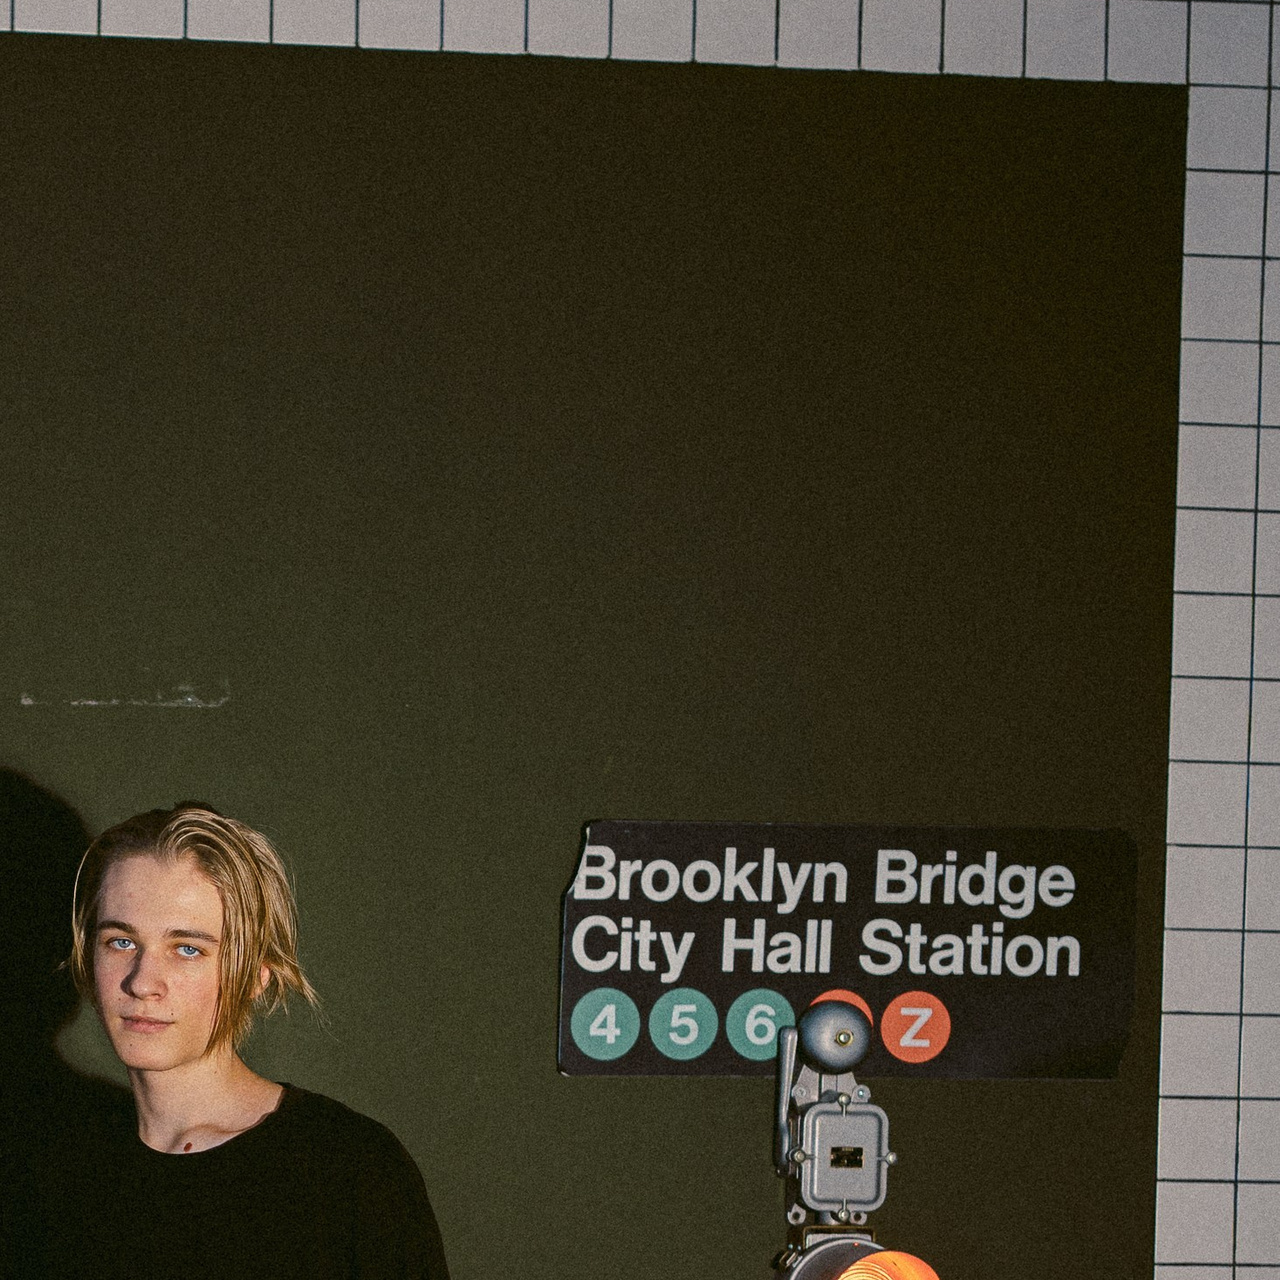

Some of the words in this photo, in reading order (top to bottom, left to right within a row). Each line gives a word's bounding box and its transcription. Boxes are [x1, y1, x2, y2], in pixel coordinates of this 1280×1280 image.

[573, 845, 848, 914] Brooklyn
[875, 849, 1076, 918] Bridge
[571, 915, 696, 983] City
[720, 917, 833, 973] Hall
[858, 918, 1081, 976] Station
[588, 1003, 621, 1044] 4
[668, 1003, 700, 1045] 5
[744, 1003, 777, 1045] 6
[899, 1007, 934, 1047] Z
